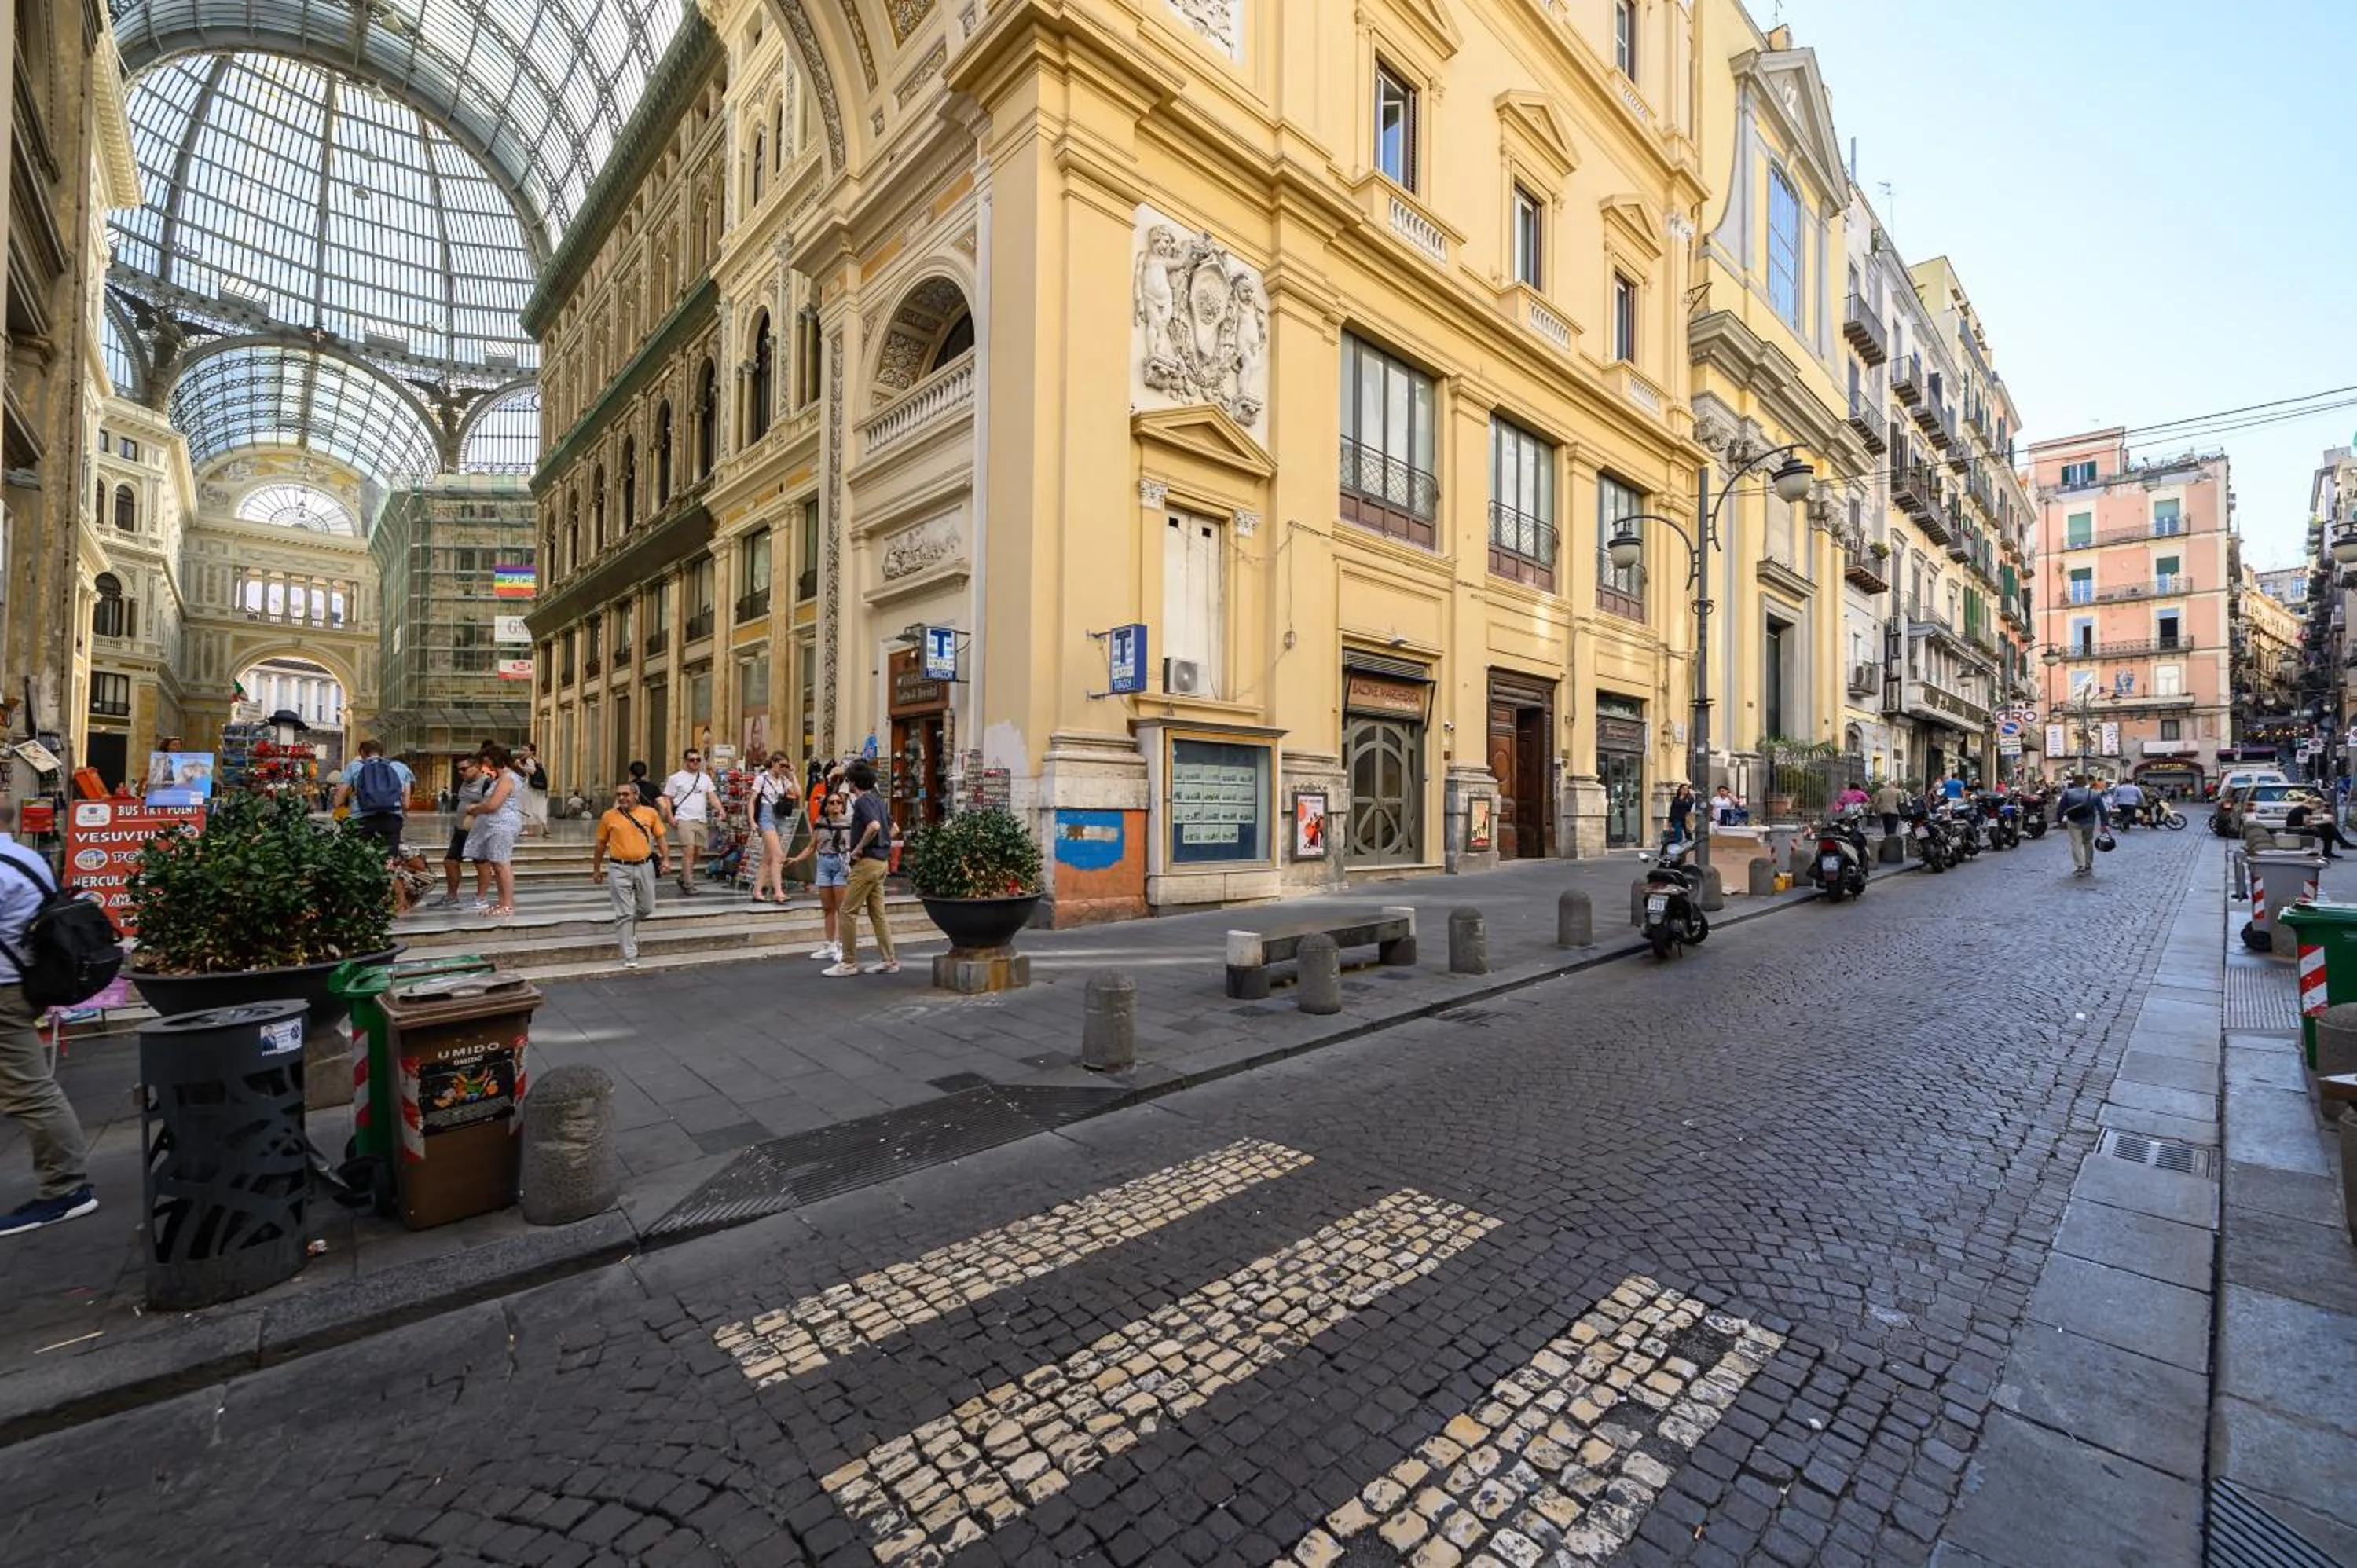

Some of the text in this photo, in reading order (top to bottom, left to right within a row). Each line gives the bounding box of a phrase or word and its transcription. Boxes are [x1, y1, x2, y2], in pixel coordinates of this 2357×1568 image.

[929, 629, 951, 658] T
[1115, 629, 1132, 663] T
[118, 805, 138, 816] BUS
[168, 805, 197, 815] POINT
[437, 1042, 500, 1059] UMIDO
